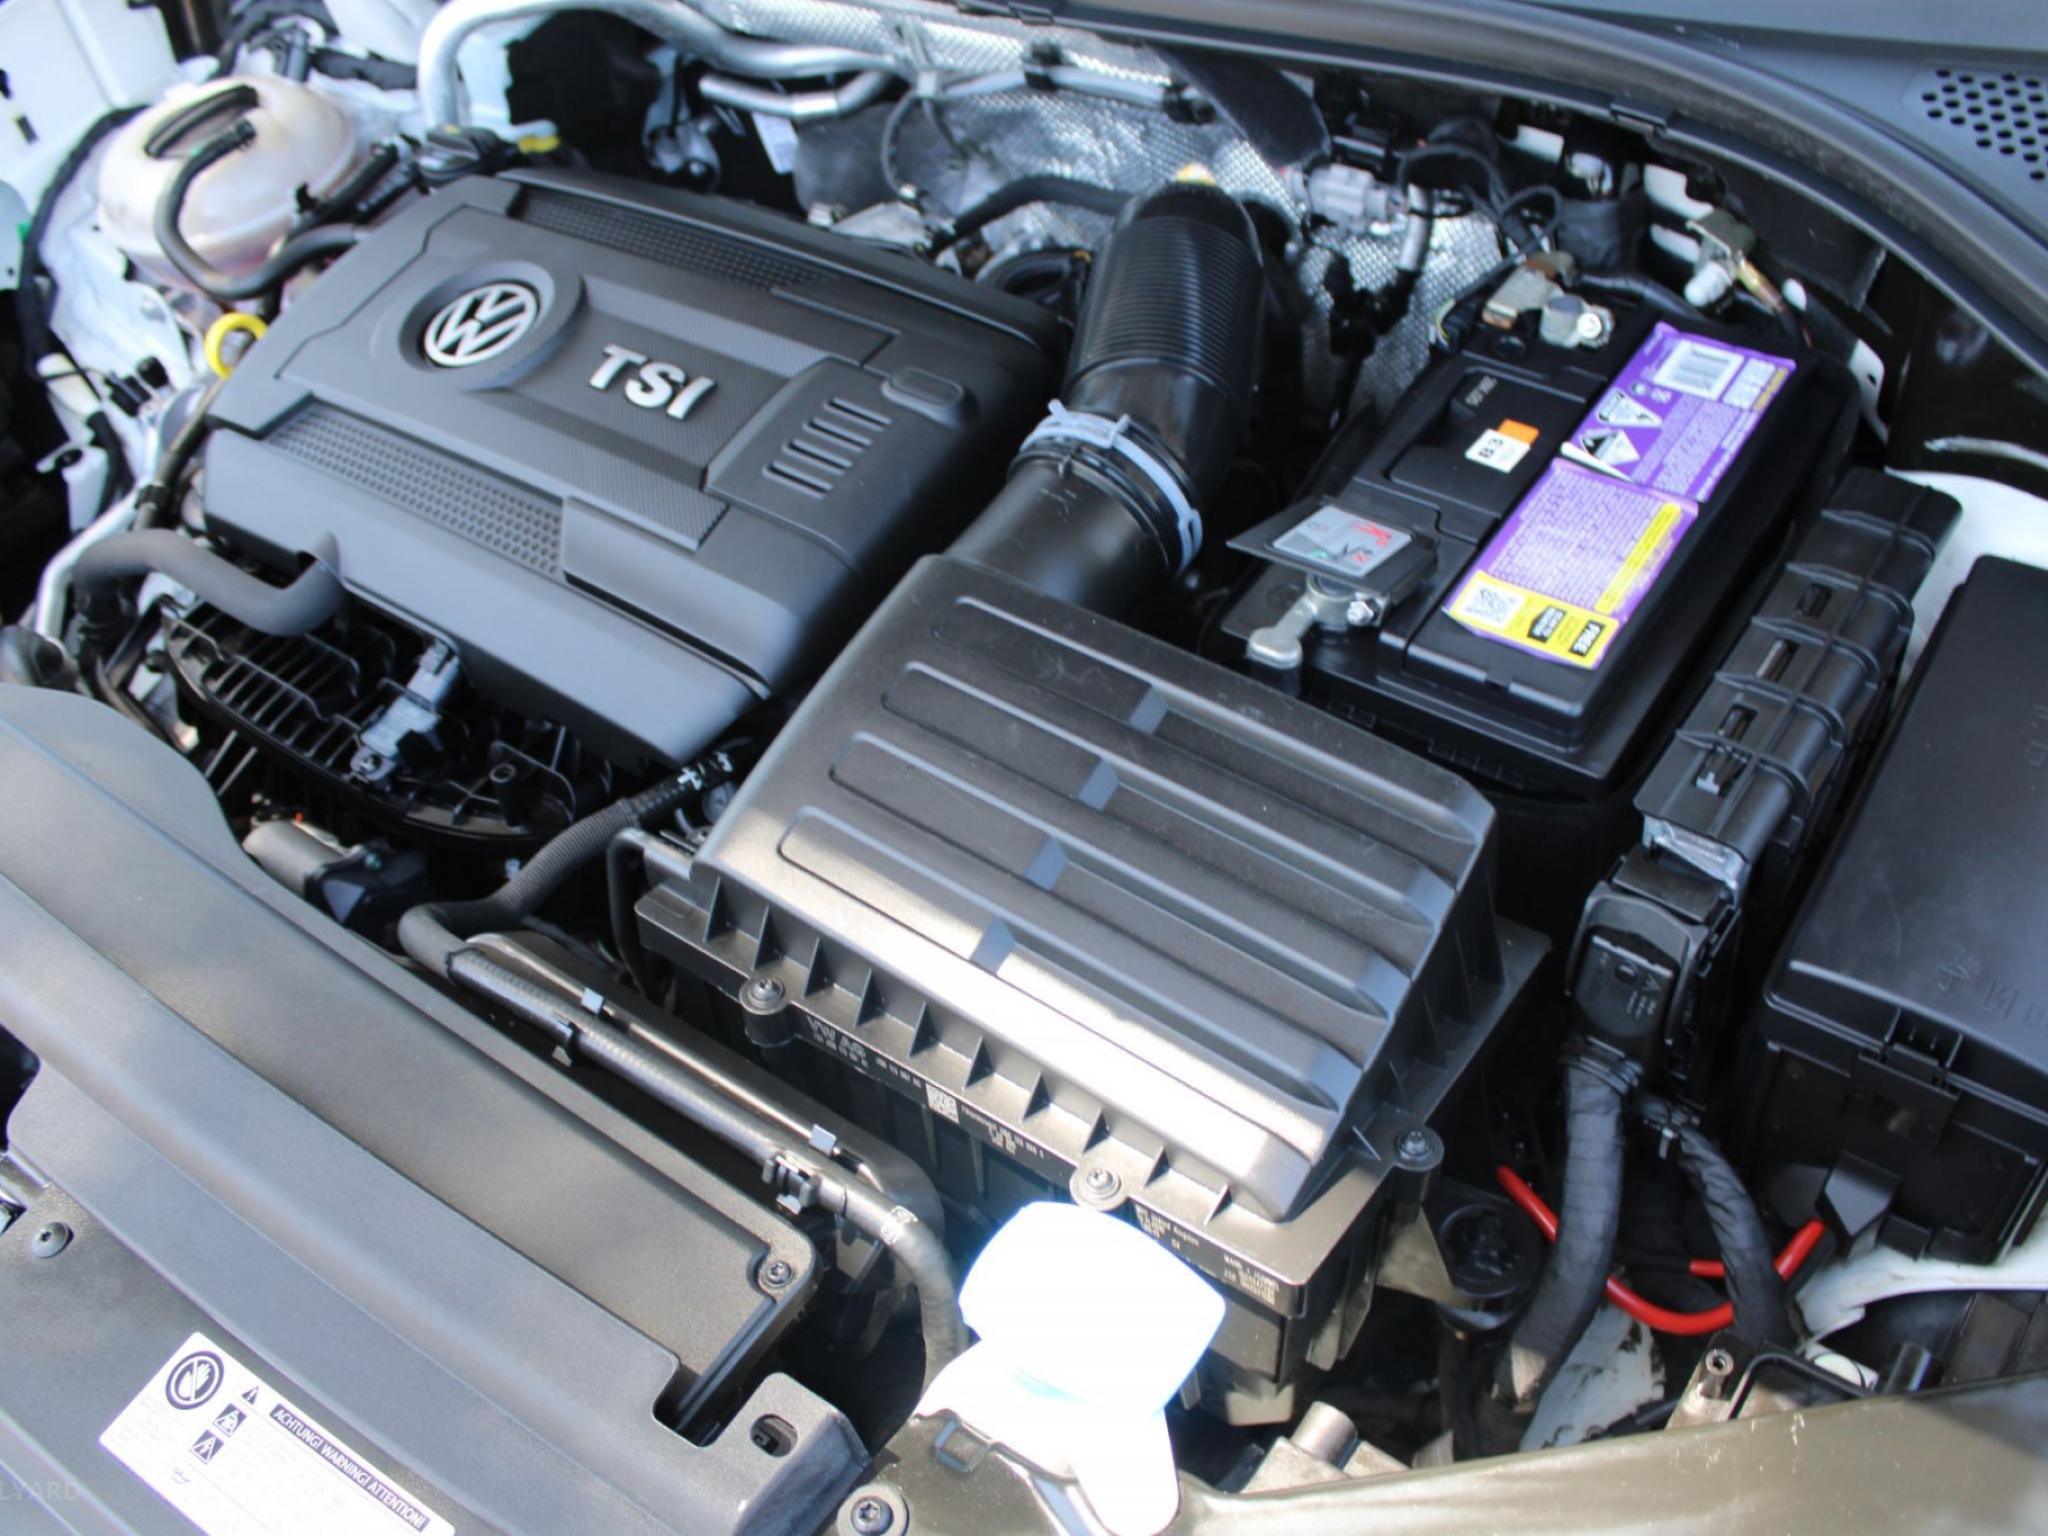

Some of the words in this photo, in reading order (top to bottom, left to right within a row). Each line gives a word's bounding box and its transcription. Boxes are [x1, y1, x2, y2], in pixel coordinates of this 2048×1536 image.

[424, 283, 537, 367] VW
[589, 344, 716, 420] TSI
[274, 1409, 322, 1449] ACHTUNG!
[321, 1443, 370, 1487] WARNING!
[367, 1480, 427, 1529] ATTENTION!
